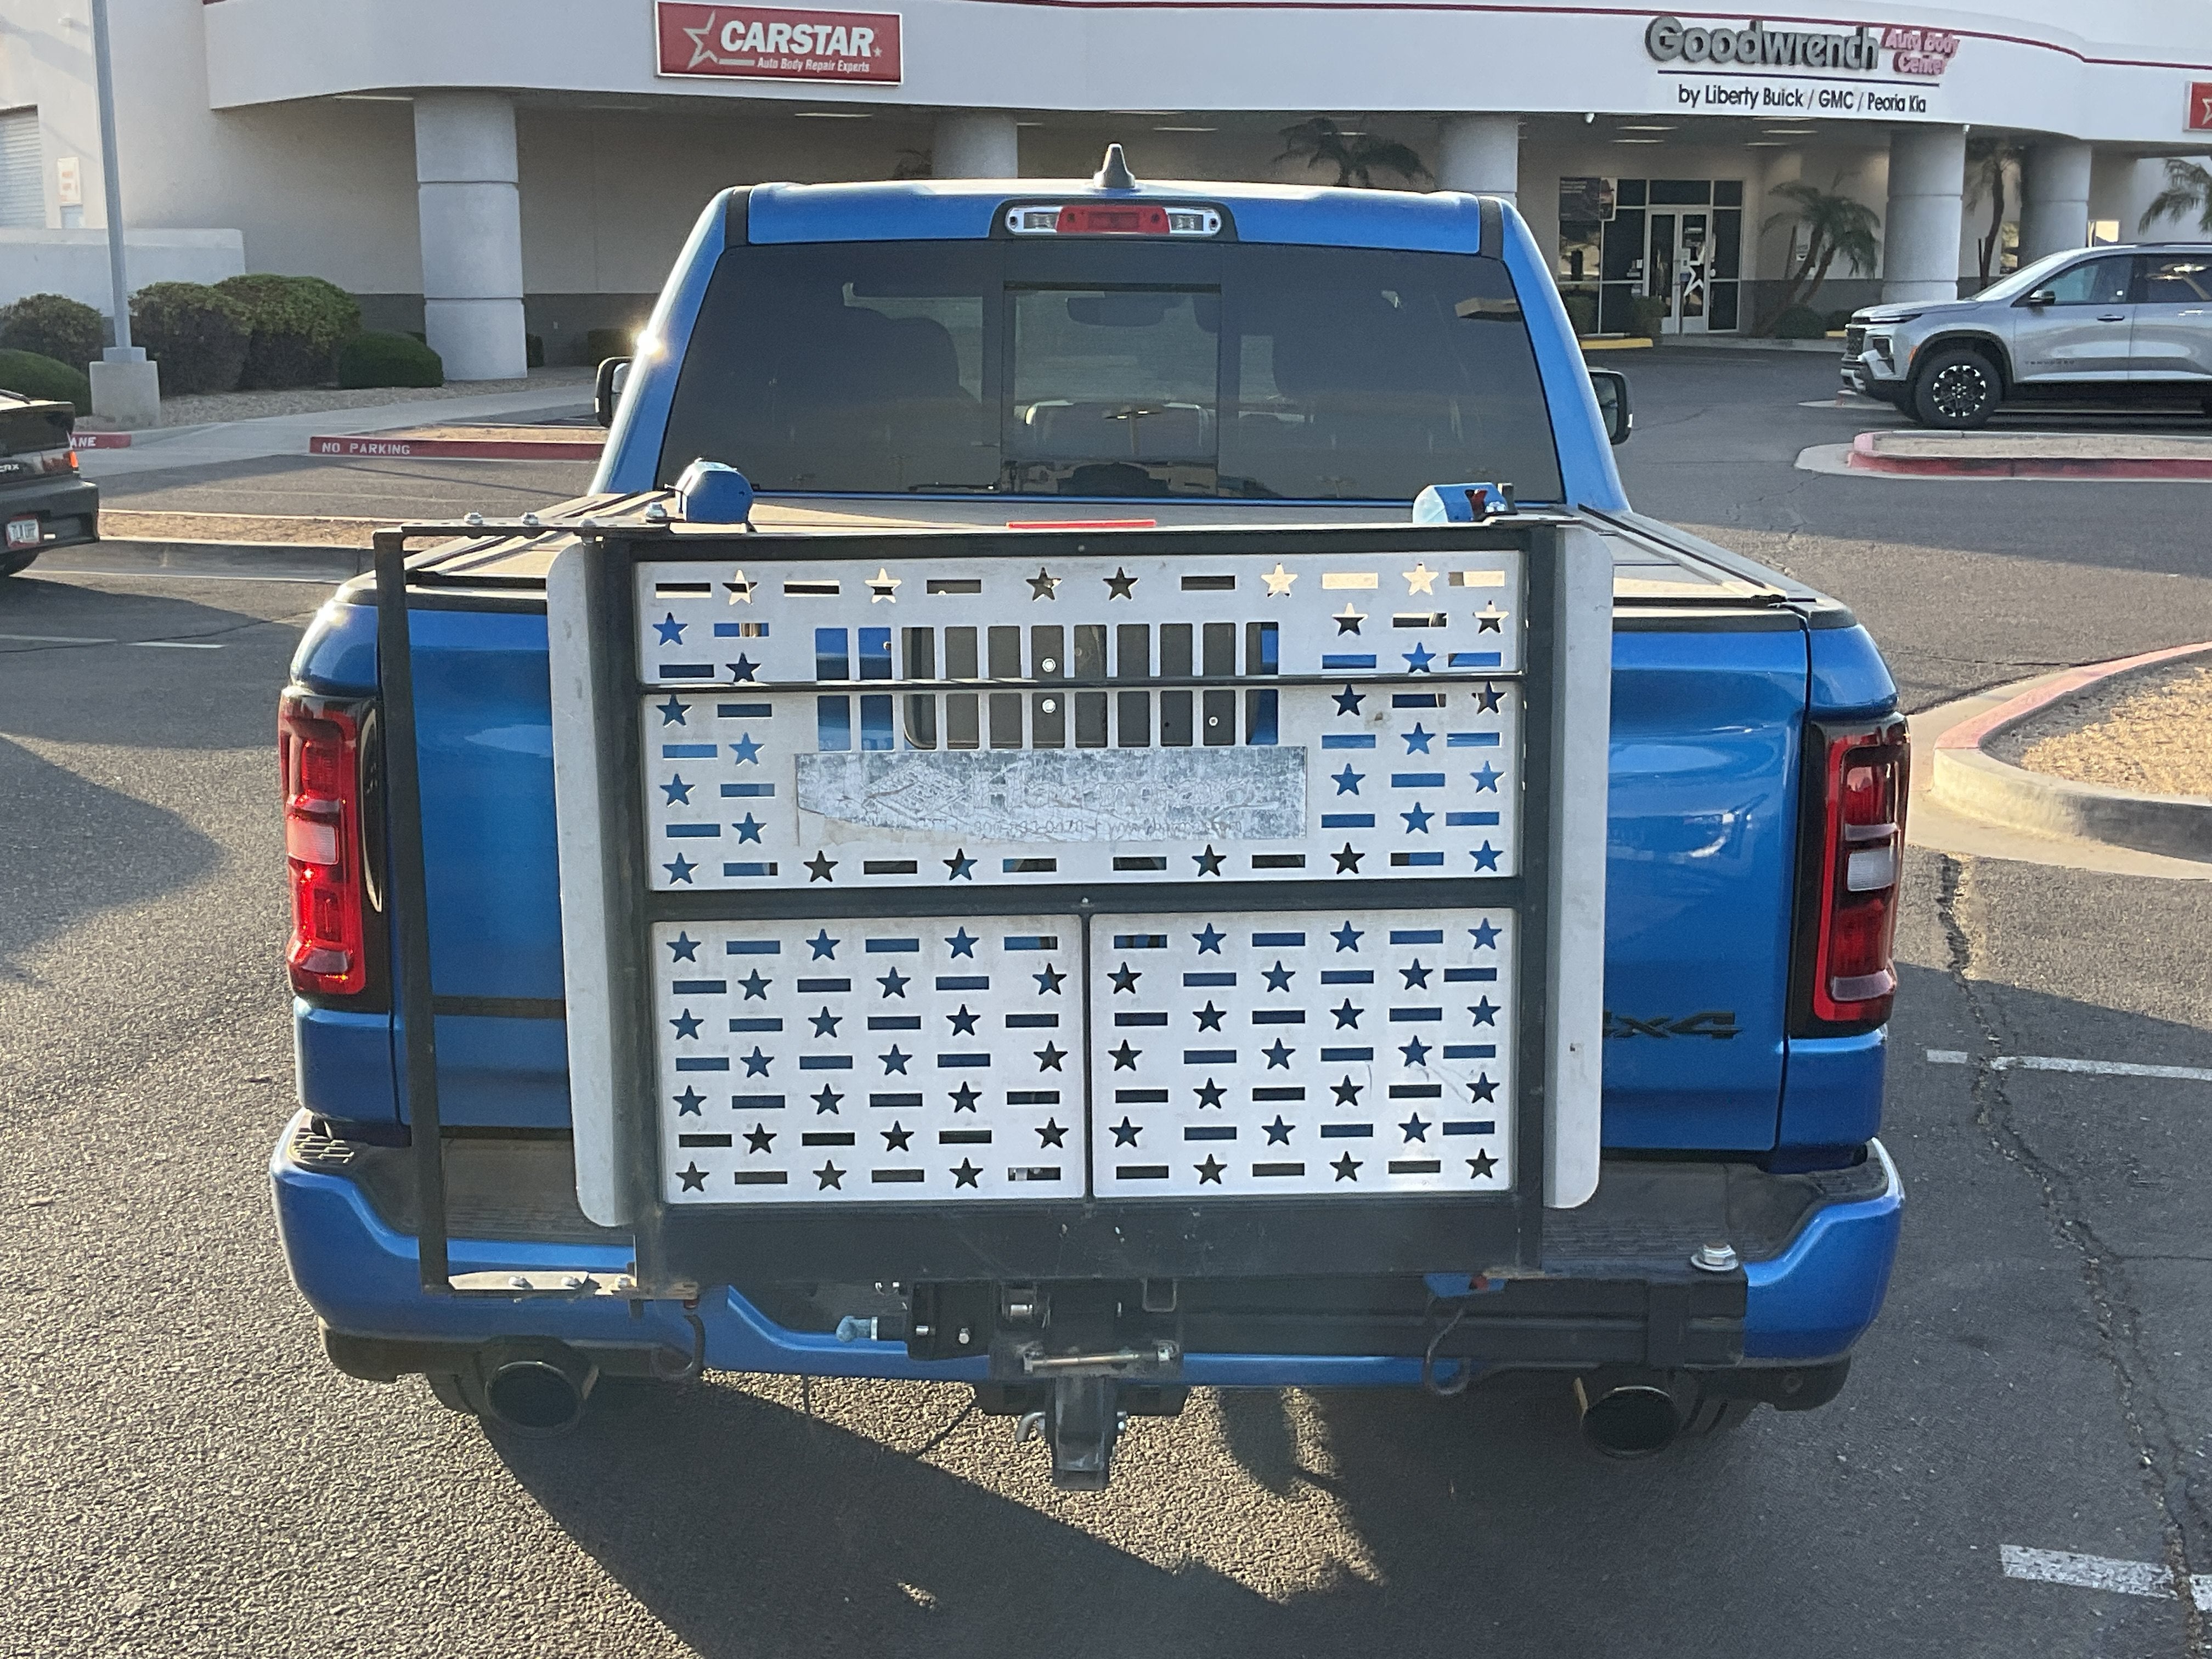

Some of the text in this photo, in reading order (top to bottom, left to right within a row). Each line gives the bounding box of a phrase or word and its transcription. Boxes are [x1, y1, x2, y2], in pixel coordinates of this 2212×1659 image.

[720, 20, 874, 57] CARSTAR
[1645, 15, 1879, 70] Goodwrench
[1881, 28, 1960, 58] Auto Body
[757, 57, 870, 73] Auto Body Repair Experts
[1678, 83, 1700, 108] by
[1705, 84, 1759, 110] Liberty
[1763, 87, 1803, 107] Buick
[1819, 89, 1854, 109] GMC
[1867, 92, 1905, 112] Peoria
[1909, 94, 1926, 113] Kia
[70, 436, 97, 447] ANE
[321, 442, 410, 455] NO PARKING
[1603, 1009, 1743, 1040] x4
